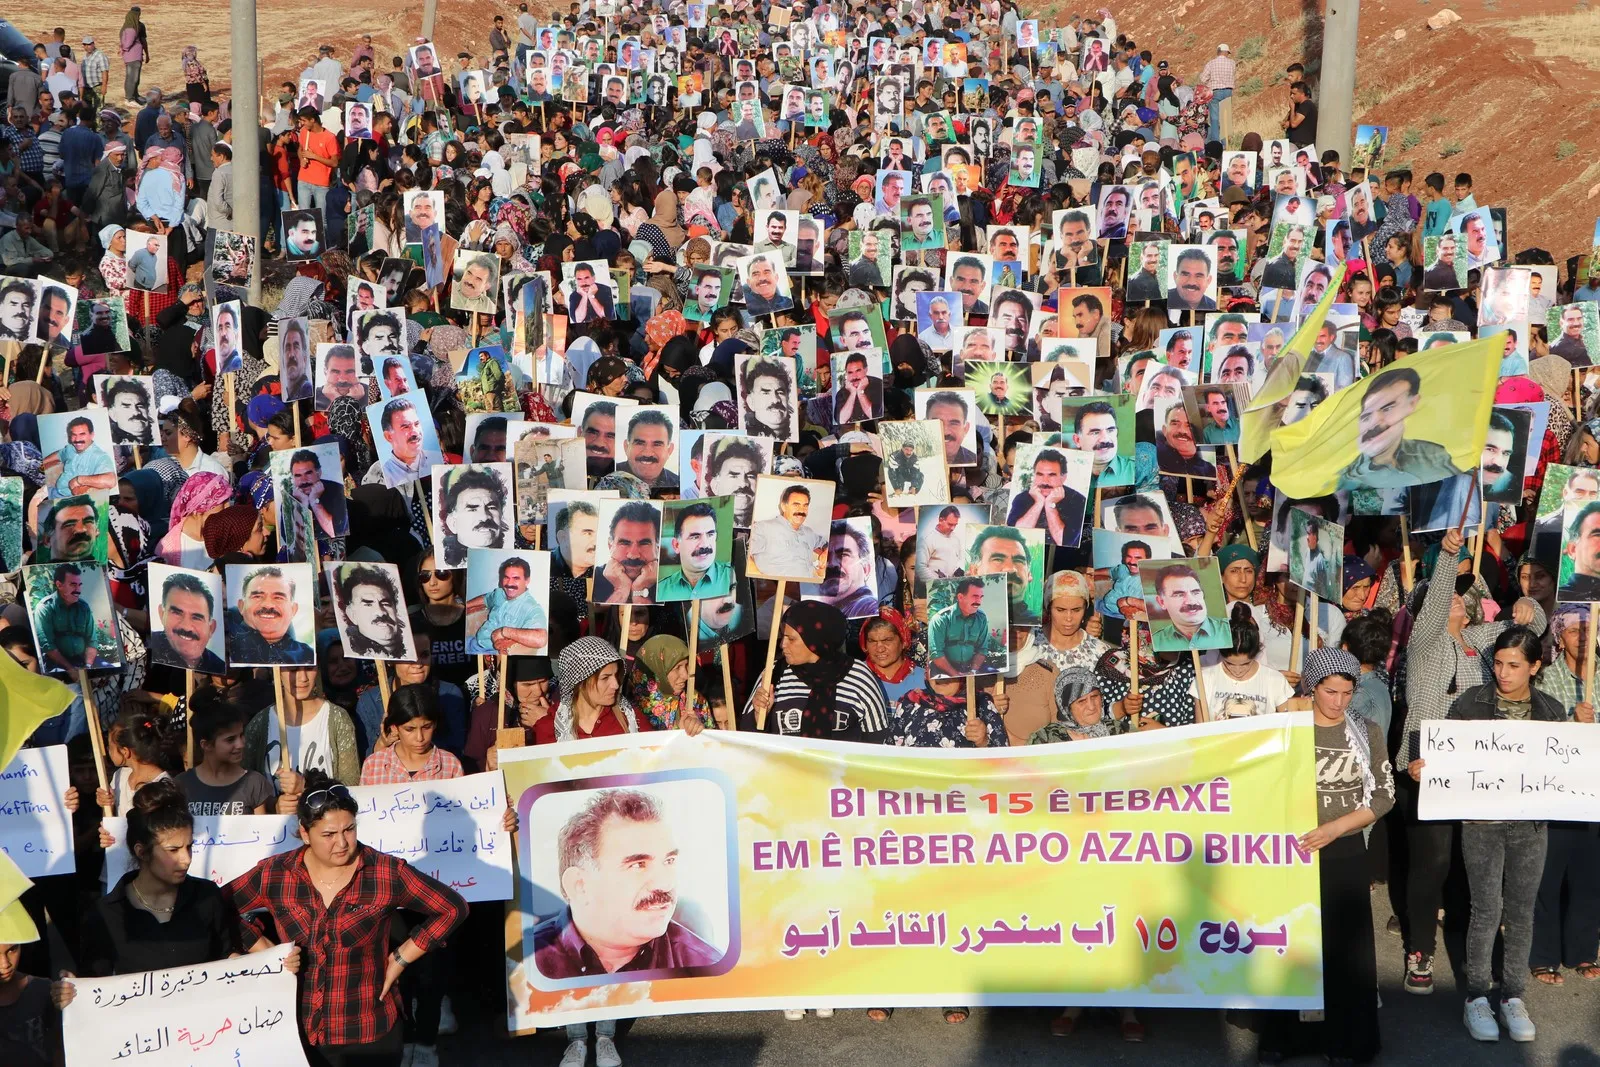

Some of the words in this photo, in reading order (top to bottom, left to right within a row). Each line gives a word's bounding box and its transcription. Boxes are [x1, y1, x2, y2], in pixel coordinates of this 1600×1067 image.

[1427, 727, 1455, 752] Kes
[1546, 736, 1581, 764] Roja
[830, 788, 865, 818] BI
[878, 790, 967, 816] RIHÊ
[979, 793, 1034, 814] 15
[1050, 789, 1070, 812] Ê
[1079, 777, 1230, 812] TEBAXÊ
[1429, 777, 1451, 789] me
[753, 840, 809, 870] EM
[822, 832, 842, 868] Ê
[853, 830, 975, 866] RÊBER
[985, 832, 1069, 863] APO
[1080, 832, 1193, 862] AZAD
[1205, 833, 1312, 864] BIKIN
[781, 910, 840, 956] آبو
[850, 911, 946, 946] القائد
[952, 914, 1061, 952] سنحرر
[1072, 906, 1115, 951] آب
[1135, 917, 1178, 951] ١٥
[1200, 921, 1287, 955] بروح
[93, 972, 154, 1008] الثورة
[112, 1026, 170, 1060] القائد
[177, 1017, 232, 1051] حرية
